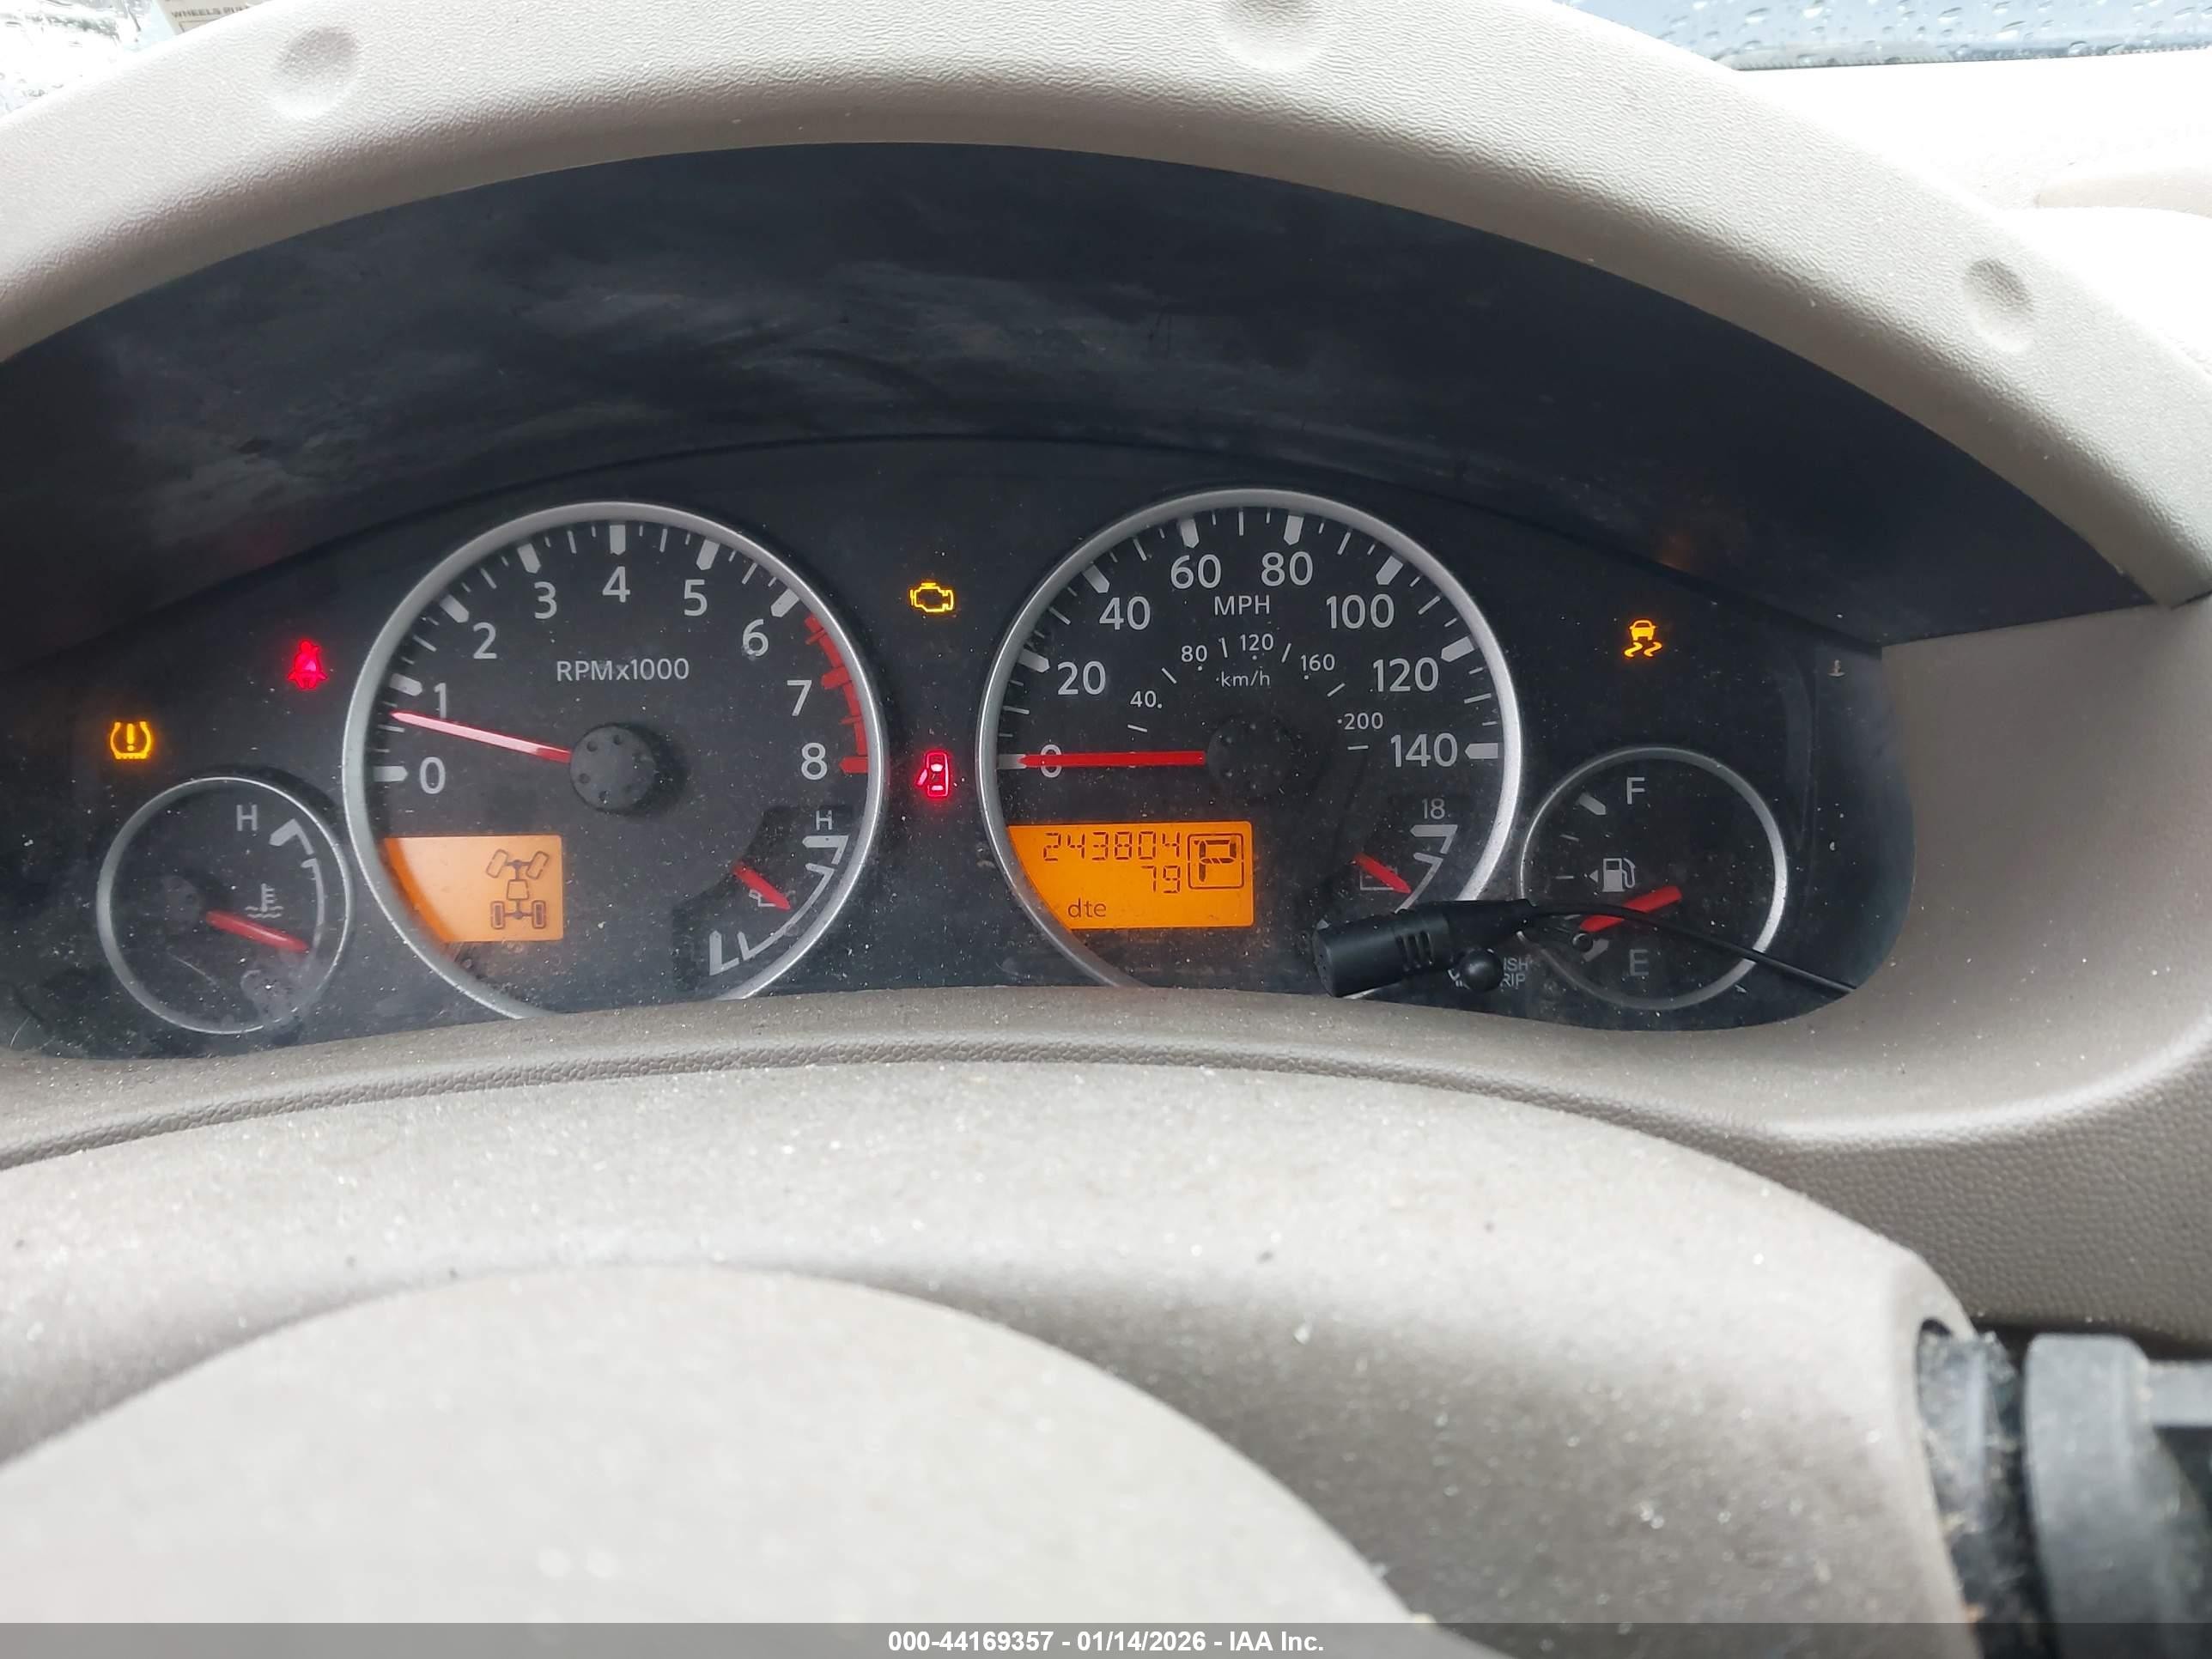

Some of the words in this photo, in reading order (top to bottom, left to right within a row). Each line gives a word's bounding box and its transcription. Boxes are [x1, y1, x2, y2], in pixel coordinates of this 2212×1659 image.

[602, 566, 631, 603] 4
[1170, 554, 1222, 589] 60
[1261, 550, 1314, 586] 80
[534, 580, 557, 620] 3
[684, 579, 708, 617] 5
[1098, 596, 1151, 630] 40
[1214, 594, 1271, 616] MPH
[1326, 593, 1395, 629] 100
[473, 622, 498, 659] 2
[742, 618, 769, 658] 6
[1181, 644, 1208, 663] 80
[1240, 633, 1274, 652] 120
[556, 658, 690, 682] RPMx1000
[1057, 660, 1107, 696] 20
[1220, 670, 1271, 688] km/h
[1300, 653, 1335, 672] 160
[1373, 657, 1440, 693] 120
[434, 682, 449, 717] 1
[787, 679, 812, 716] 7
[1129, 690, 1158, 708] 40
[1343, 712, 1384, 730] 200
[800, 742, 829, 781] 8
[1040, 744, 1063, 778] 0
[1390, 732, 1459, 769] 140
[419, 757, 447, 794] 0
[1626, 776, 1646, 805] F
[236, 804, 258, 832] H
[816, 810, 833, 831] H
[1422, 798, 1446, 820] 18
[1043, 830, 1181, 861] 243804
[1194, 838, 1237, 883] P
[1140, 864, 1181, 894] 79
[1067, 898, 1107, 918] dte
[1629, 948, 1650, 977] E
[1499, 972, 1526, 988] RIP
